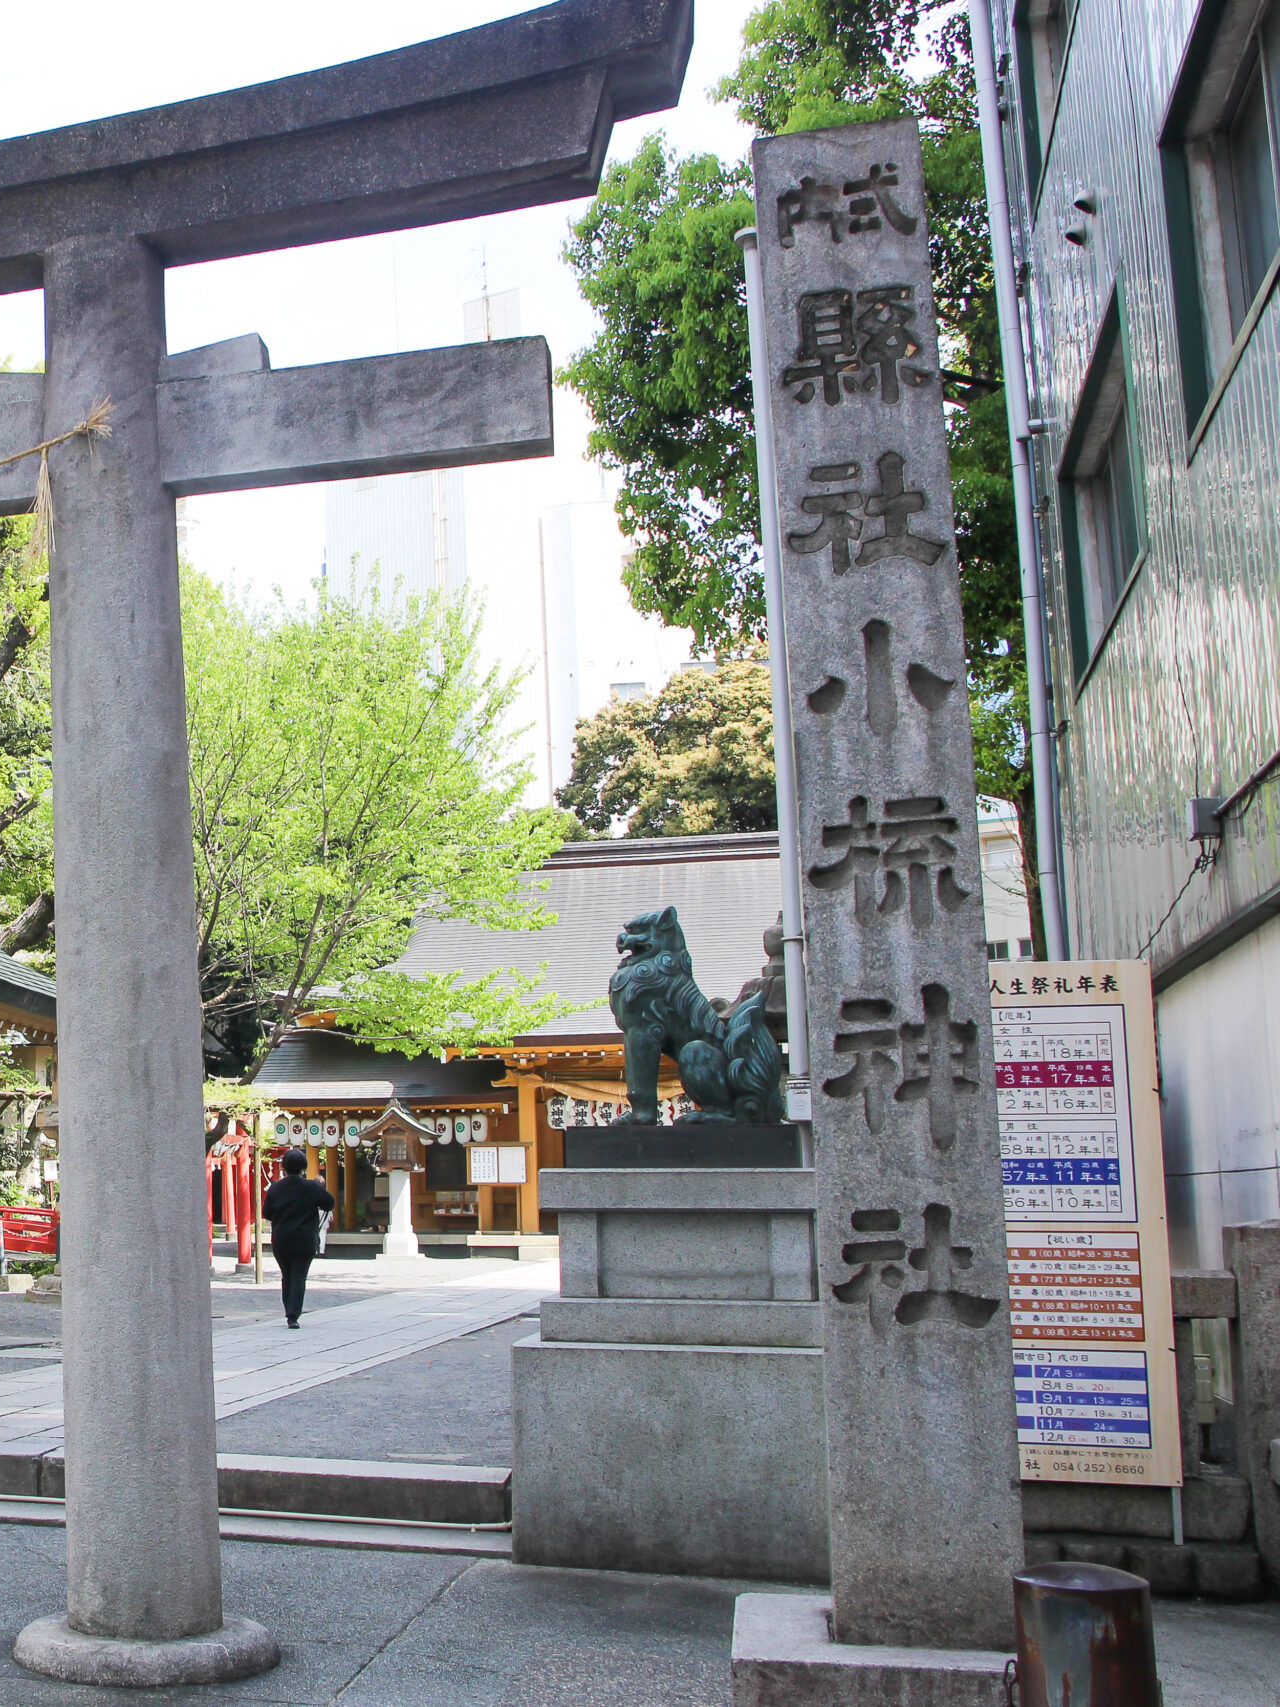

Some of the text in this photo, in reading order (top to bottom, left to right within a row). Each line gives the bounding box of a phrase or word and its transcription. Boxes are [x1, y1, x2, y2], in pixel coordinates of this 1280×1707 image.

[990, 974, 1119, 995] 人生祭礼年表
